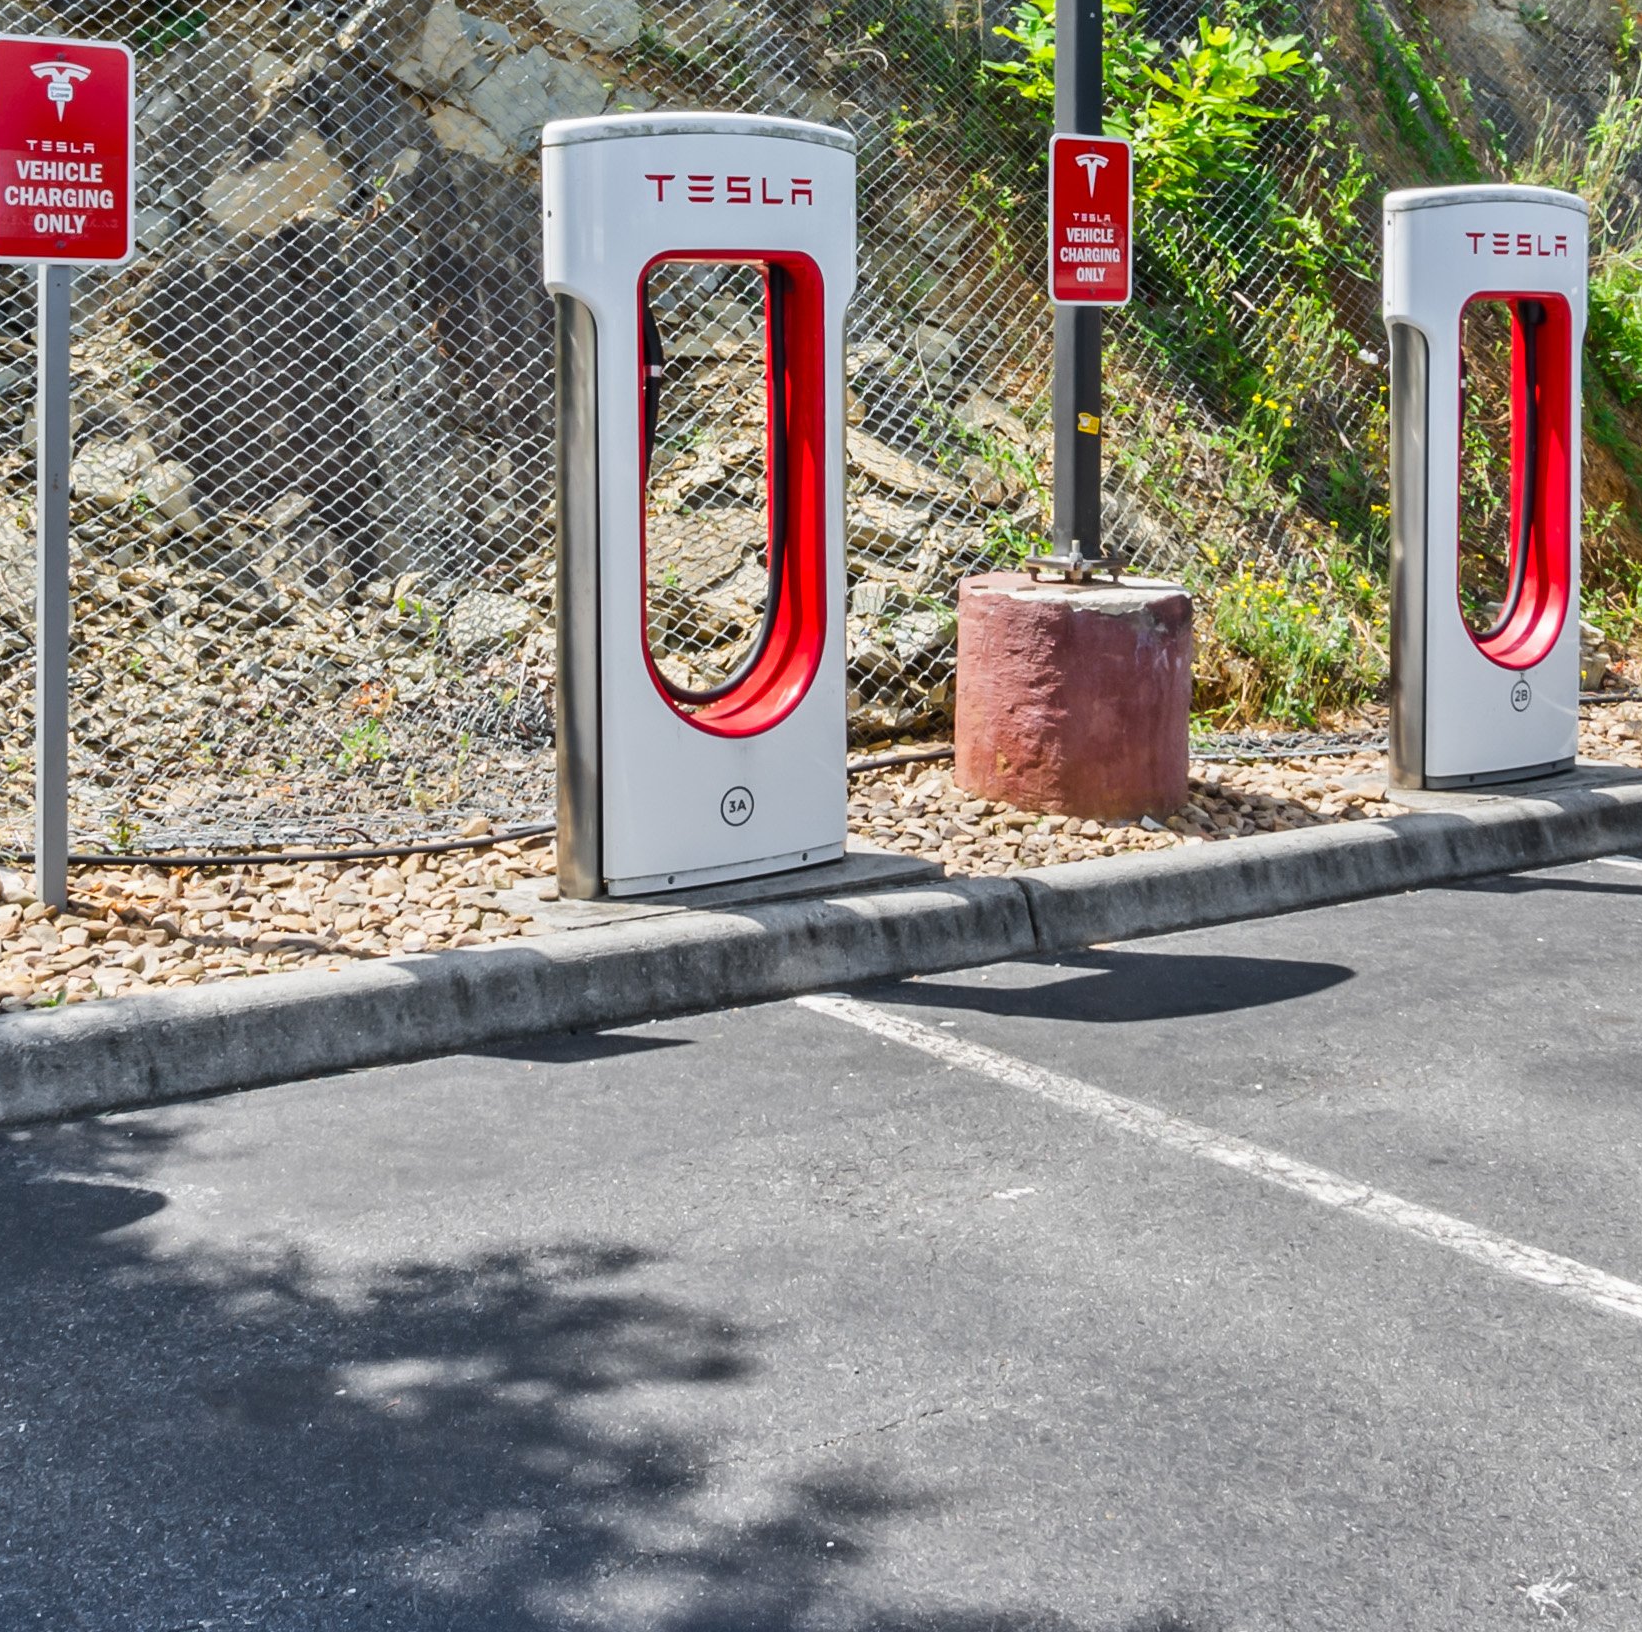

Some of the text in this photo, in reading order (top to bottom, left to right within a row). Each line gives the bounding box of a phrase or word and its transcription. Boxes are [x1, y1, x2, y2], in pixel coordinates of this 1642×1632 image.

[25, 139, 95, 154] TESLA
[16, 160, 103, 183] VEHICLE
[4, 185, 114, 209] CHARGING
[644, 174, 813, 206] TESLA
[33, 213, 87, 234] ONLY
[1072, 212, 1111, 223] TESLA
[1066, 227, 1114, 244] VEHICLE
[1465, 232, 1567, 257] TESLA
[1060, 247, 1120, 263] CHARGING
[1076, 266, 1106, 283] ONLY
[1514, 689, 1528, 702] 2B
[728, 798, 747, 813] 3A
